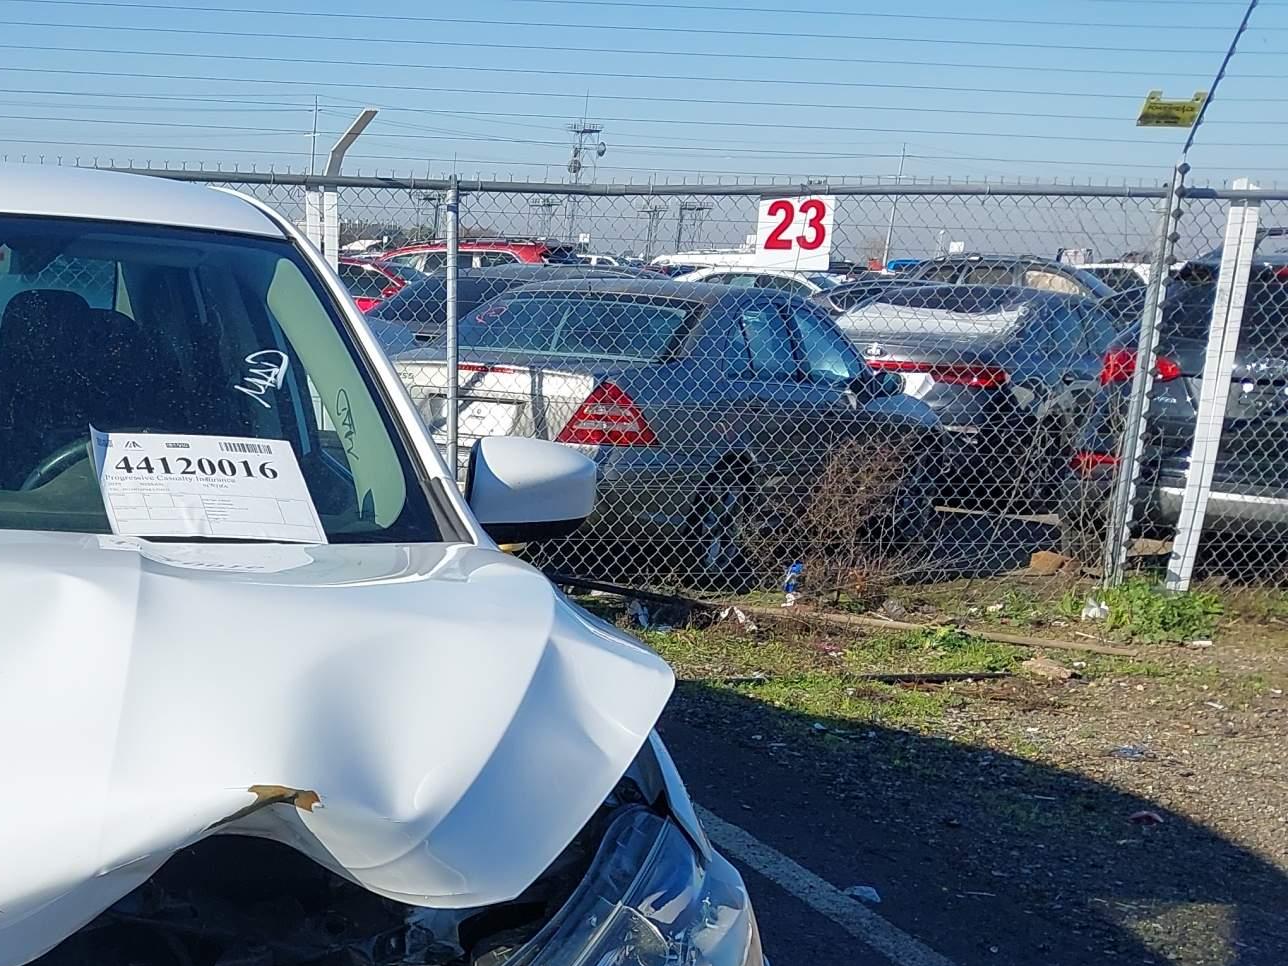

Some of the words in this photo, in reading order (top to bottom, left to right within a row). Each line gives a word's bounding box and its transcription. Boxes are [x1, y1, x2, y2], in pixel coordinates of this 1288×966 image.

[764, 200, 826, 250] 23
[105, 474, 154, 482] Progressive
[157, 474, 193, 483] Casualty
[115, 456, 278, 480] 44120016
